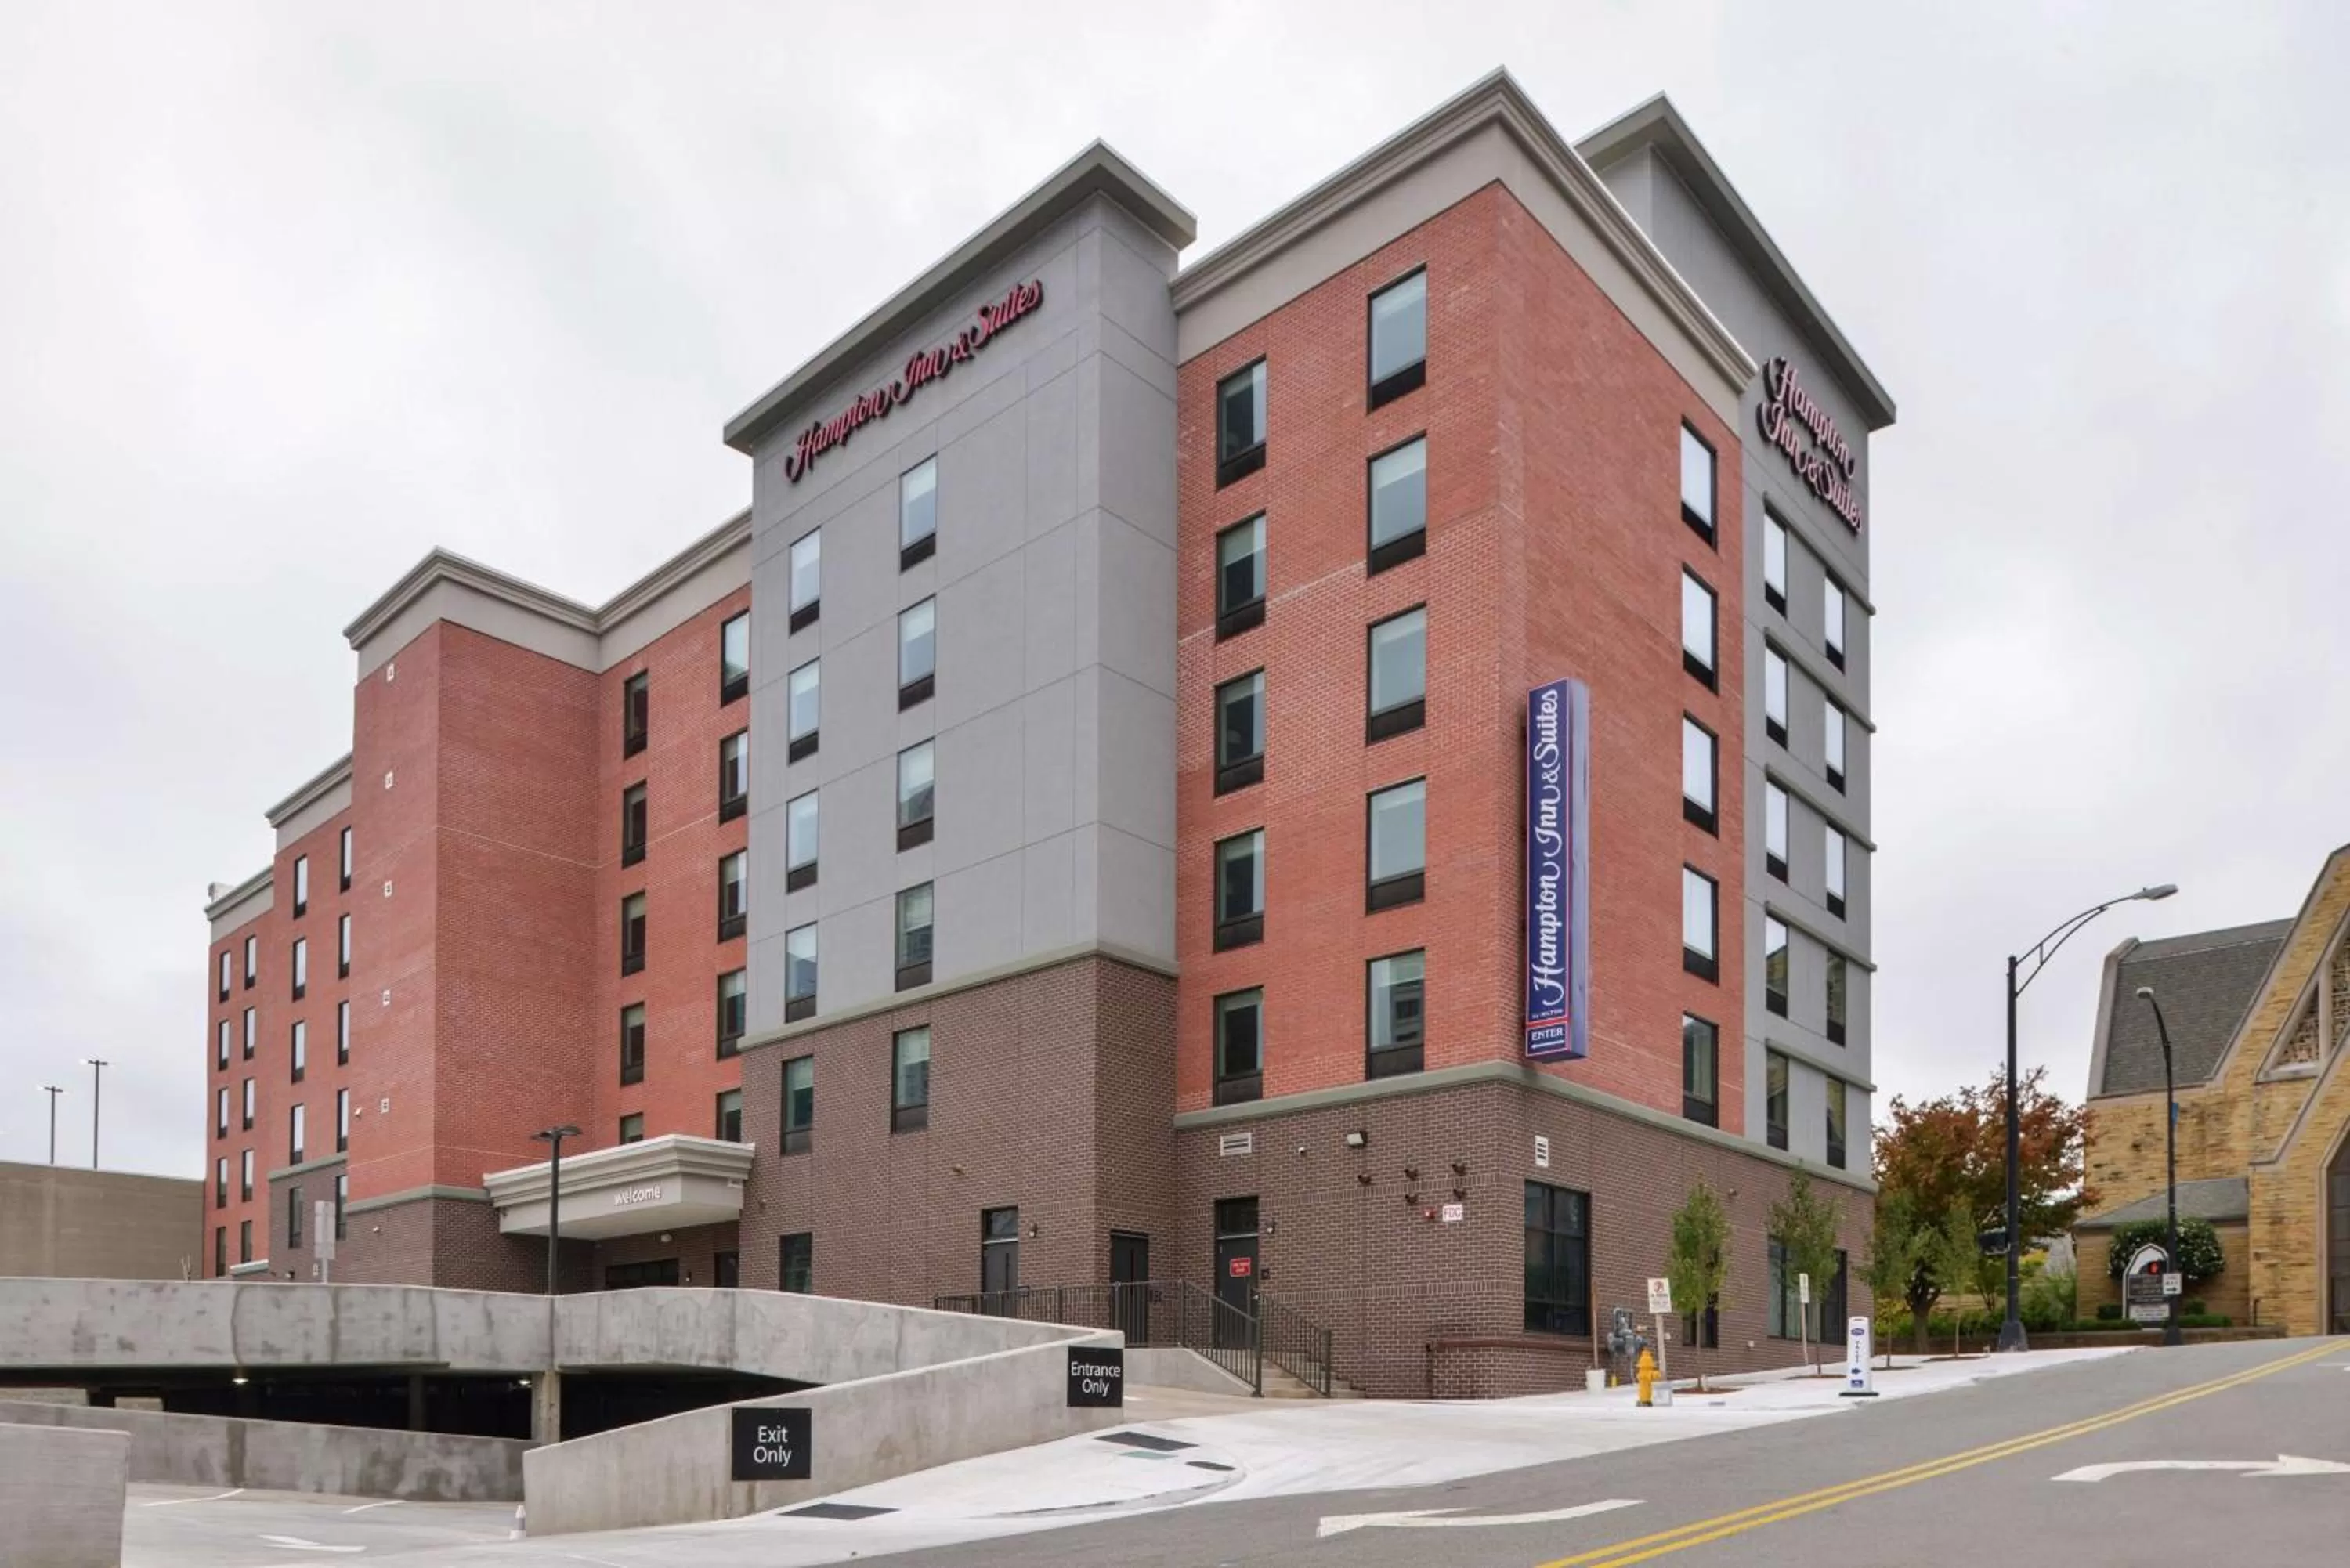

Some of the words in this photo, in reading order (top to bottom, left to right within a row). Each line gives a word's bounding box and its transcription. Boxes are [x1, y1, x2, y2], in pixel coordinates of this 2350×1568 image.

[786, 382, 893, 483] Hampton
[891, 343, 954, 406] Inn
[951, 331, 974, 362] &
[969, 279, 1044, 350] Suites
[1763, 356, 1855, 481] Hampton
[1755, 400, 1809, 476] Inn
[1806, 453, 1821, 497] &
[1817, 461, 1862, 536] Suites
[1533, 688, 1560, 768] Suites
[1541, 761, 1561, 783] &
[1535, 784, 1562, 858] Inn
[1531, 860, 1564, 1006] Hampton
[1531, 1027, 1564, 1041] ENTER
[613, 1185, 662, 1206] welcome
[1071, 1361, 1121, 1378] Entrance
[1082, 1378, 1110, 1397] Only
[757, 1425, 788, 1443] Exit
[753, 1445, 792, 1467] Only
